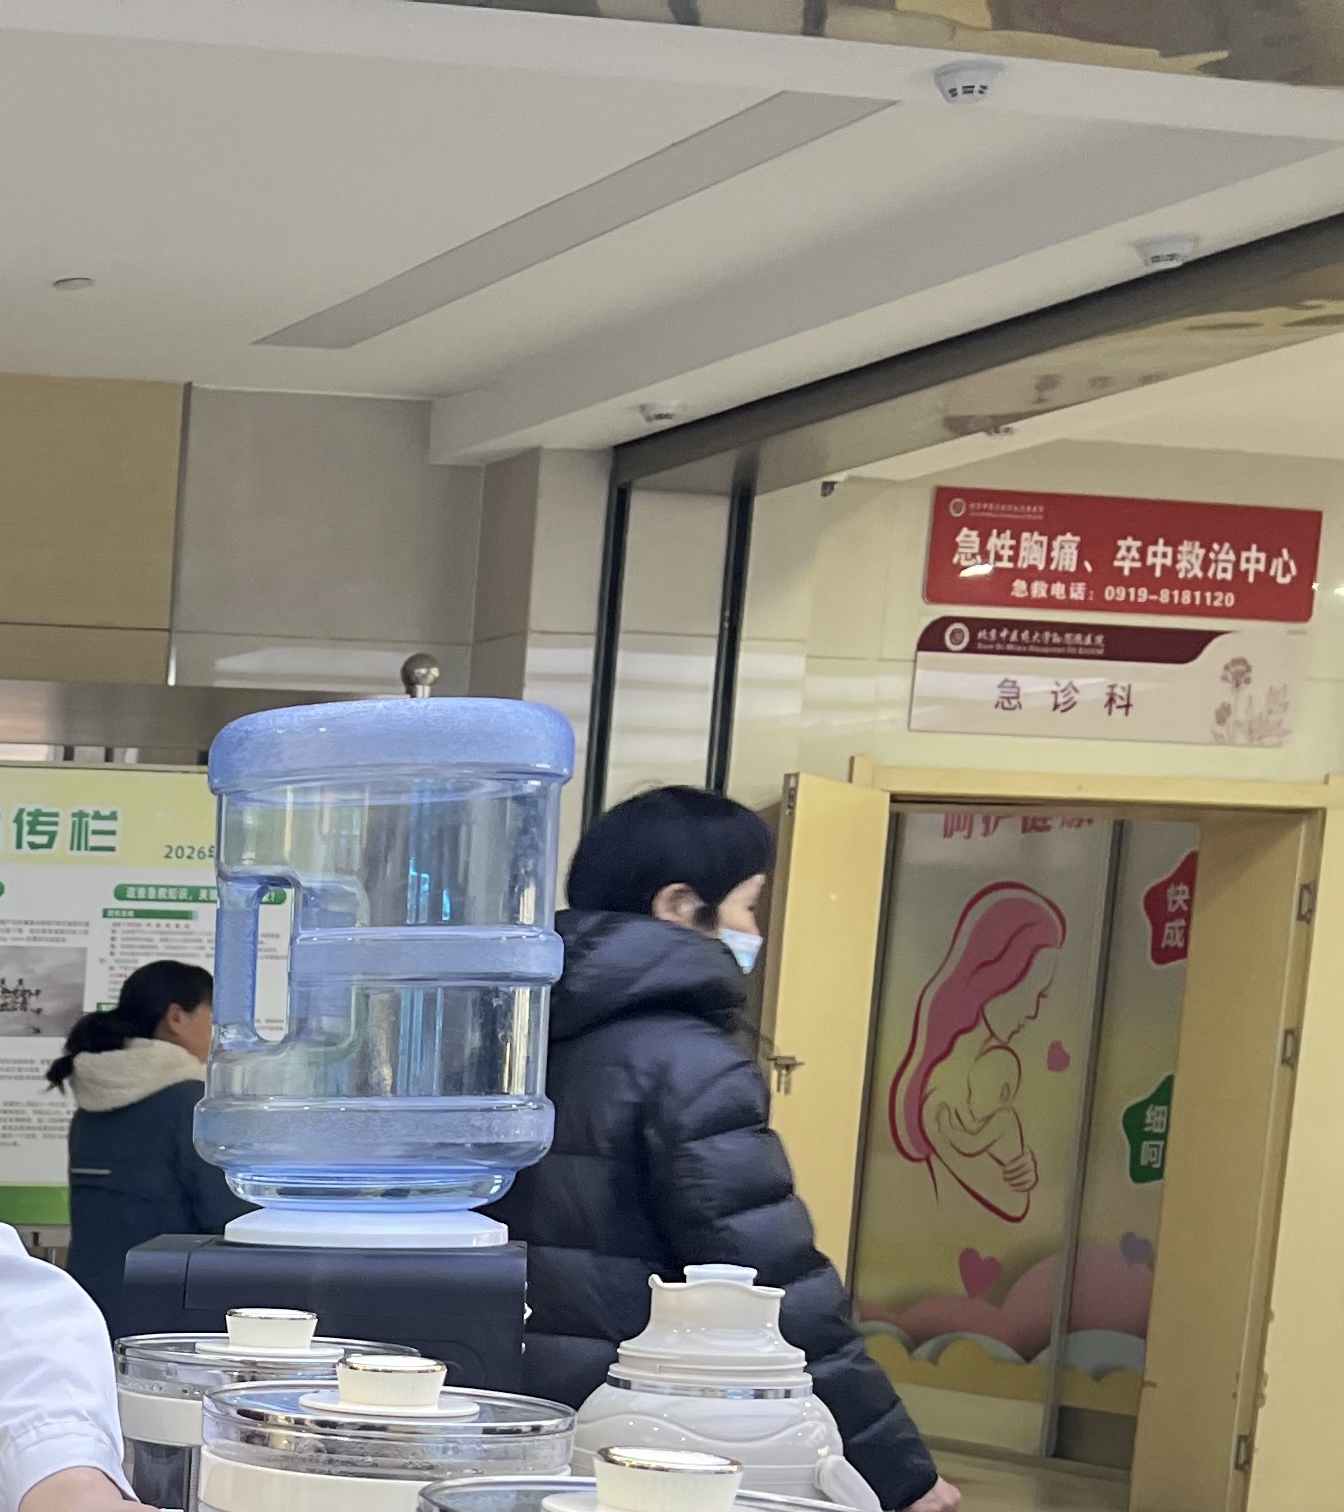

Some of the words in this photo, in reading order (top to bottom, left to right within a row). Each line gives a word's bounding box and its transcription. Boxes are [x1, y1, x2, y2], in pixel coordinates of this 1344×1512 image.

[952, 526, 1298, 585] 急性胸痛、卒中救治中心
[994, 677, 1134, 717] 急诊科
